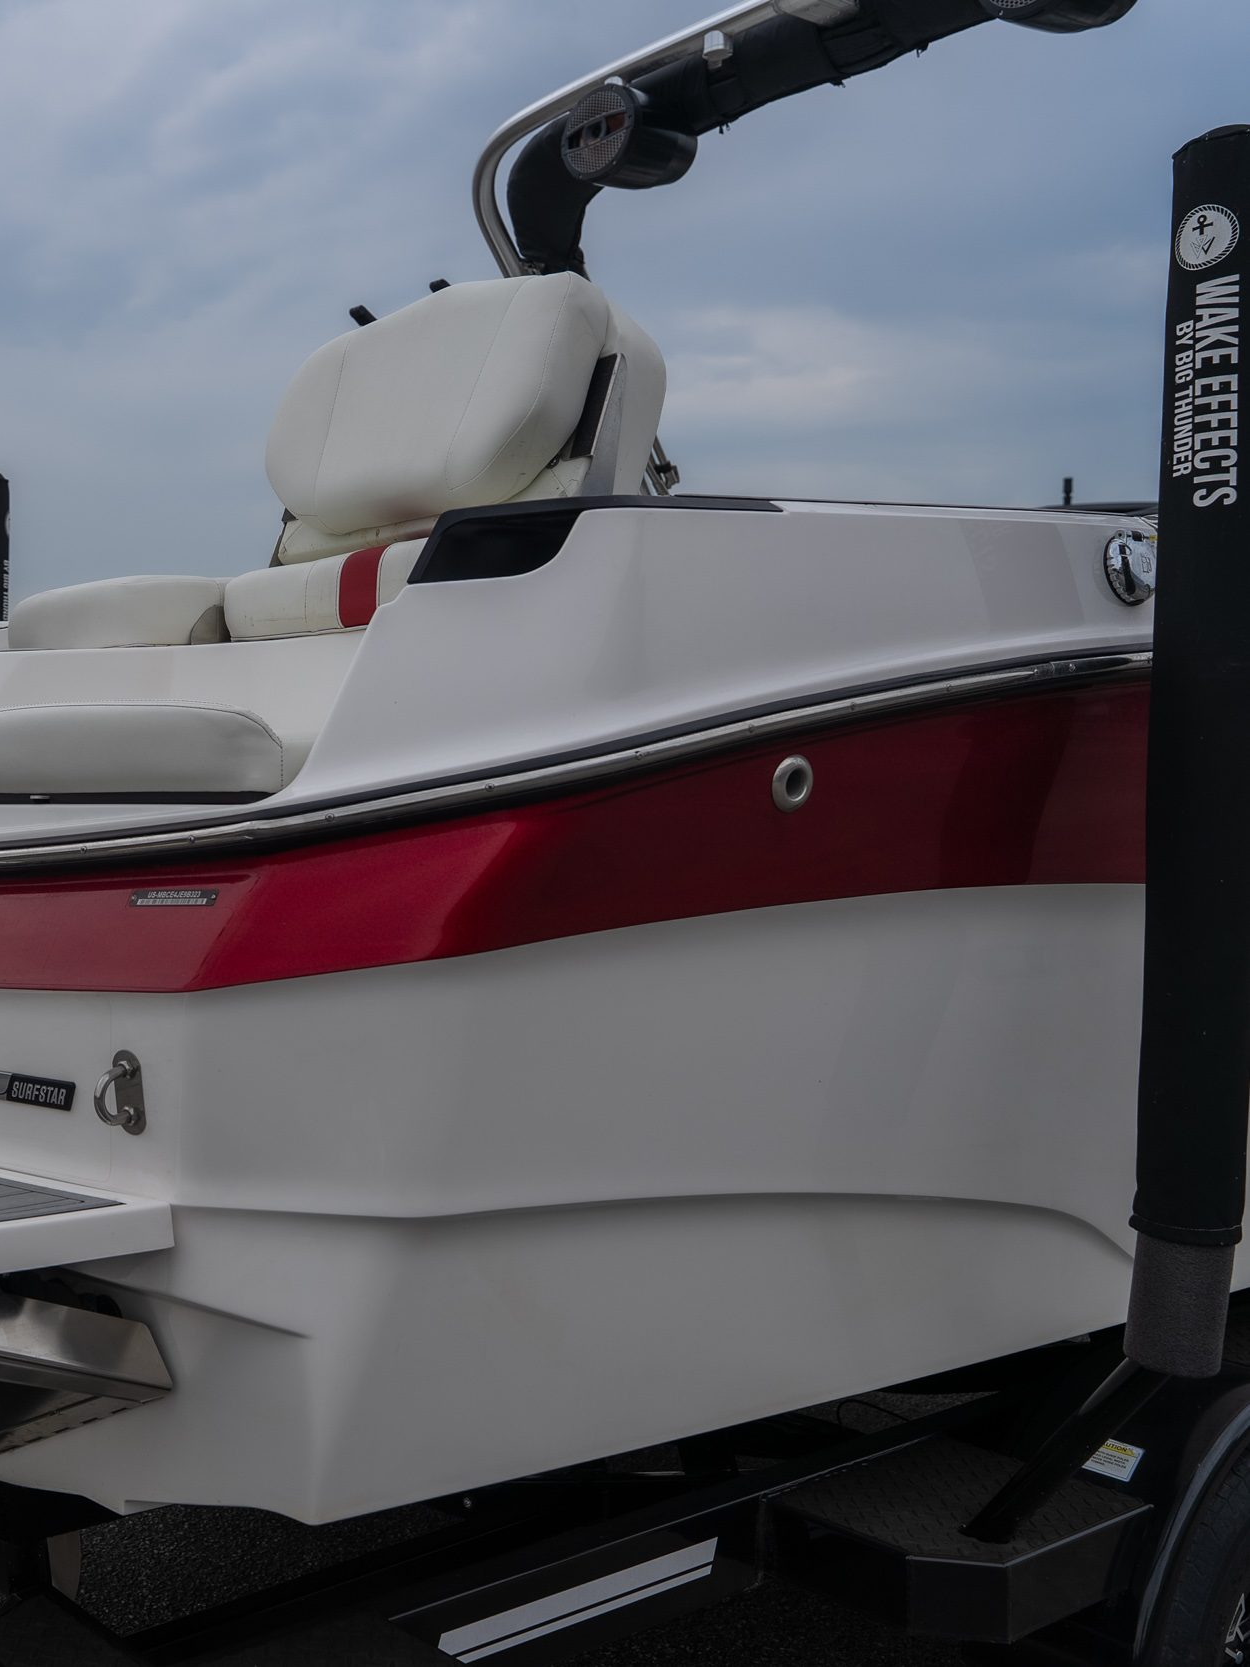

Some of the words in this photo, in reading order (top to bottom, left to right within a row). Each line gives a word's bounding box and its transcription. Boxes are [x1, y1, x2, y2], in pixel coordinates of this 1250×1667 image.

[1175, 319, 1194, 346] BY
[1195, 273, 1240, 369] WAKE
[1175, 354, 1194, 385] BIG
[1172, 387, 1194, 478] THUNDER
[1192, 373, 1239, 508] EFFECTS
[11, 1081, 66, 1105] SURFSTAR
[1104, 1442, 1127, 1452] UTION
